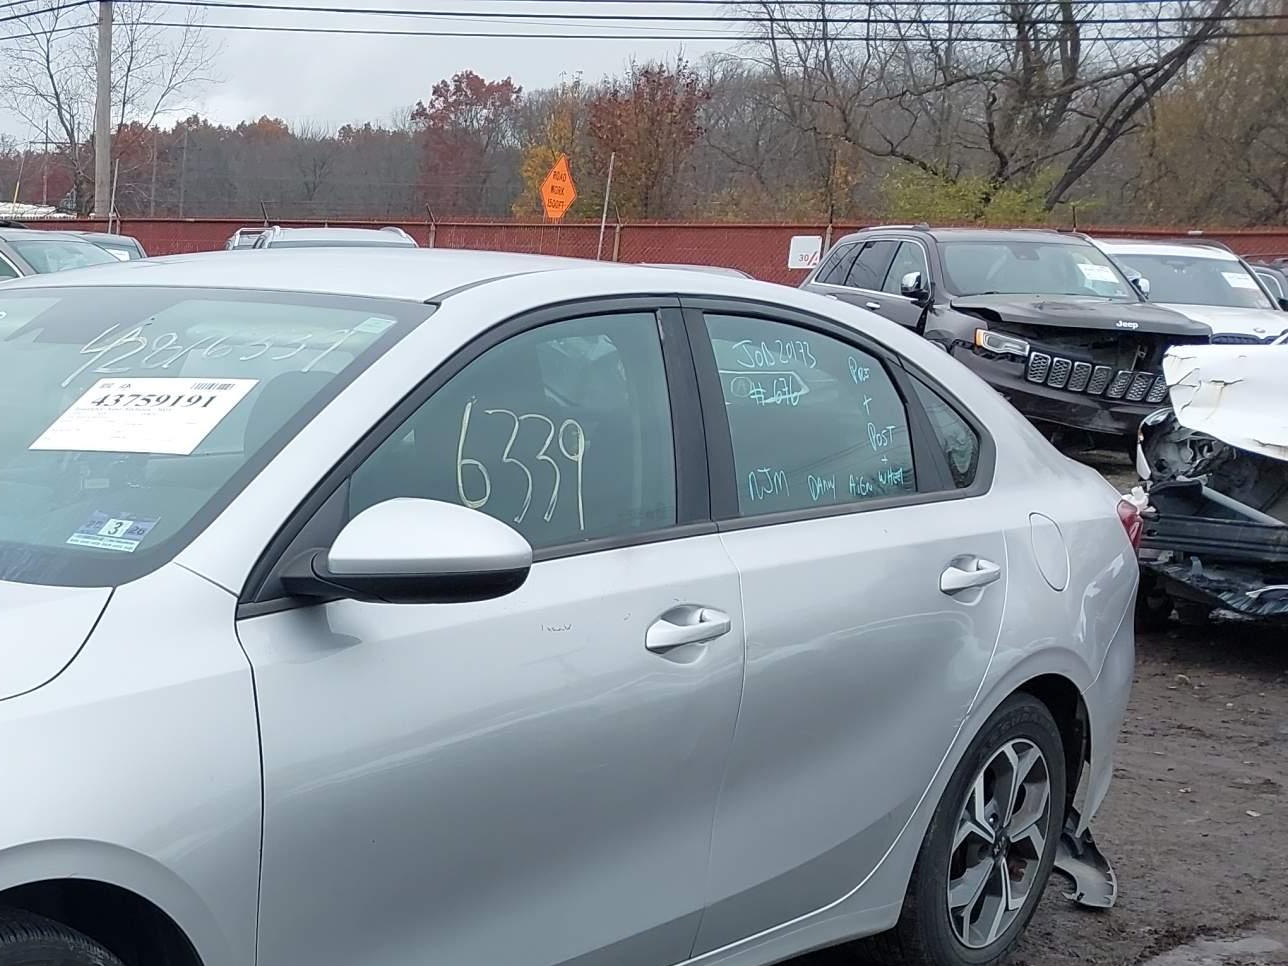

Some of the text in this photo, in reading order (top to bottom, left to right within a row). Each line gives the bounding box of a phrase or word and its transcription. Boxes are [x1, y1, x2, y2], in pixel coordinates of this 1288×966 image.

[1115, 320, 1139, 330] Jeep
[90, 393, 218, 409] 43759191
[456, 401, 585, 531] 6339
[107, 521, 124, 535] 3
